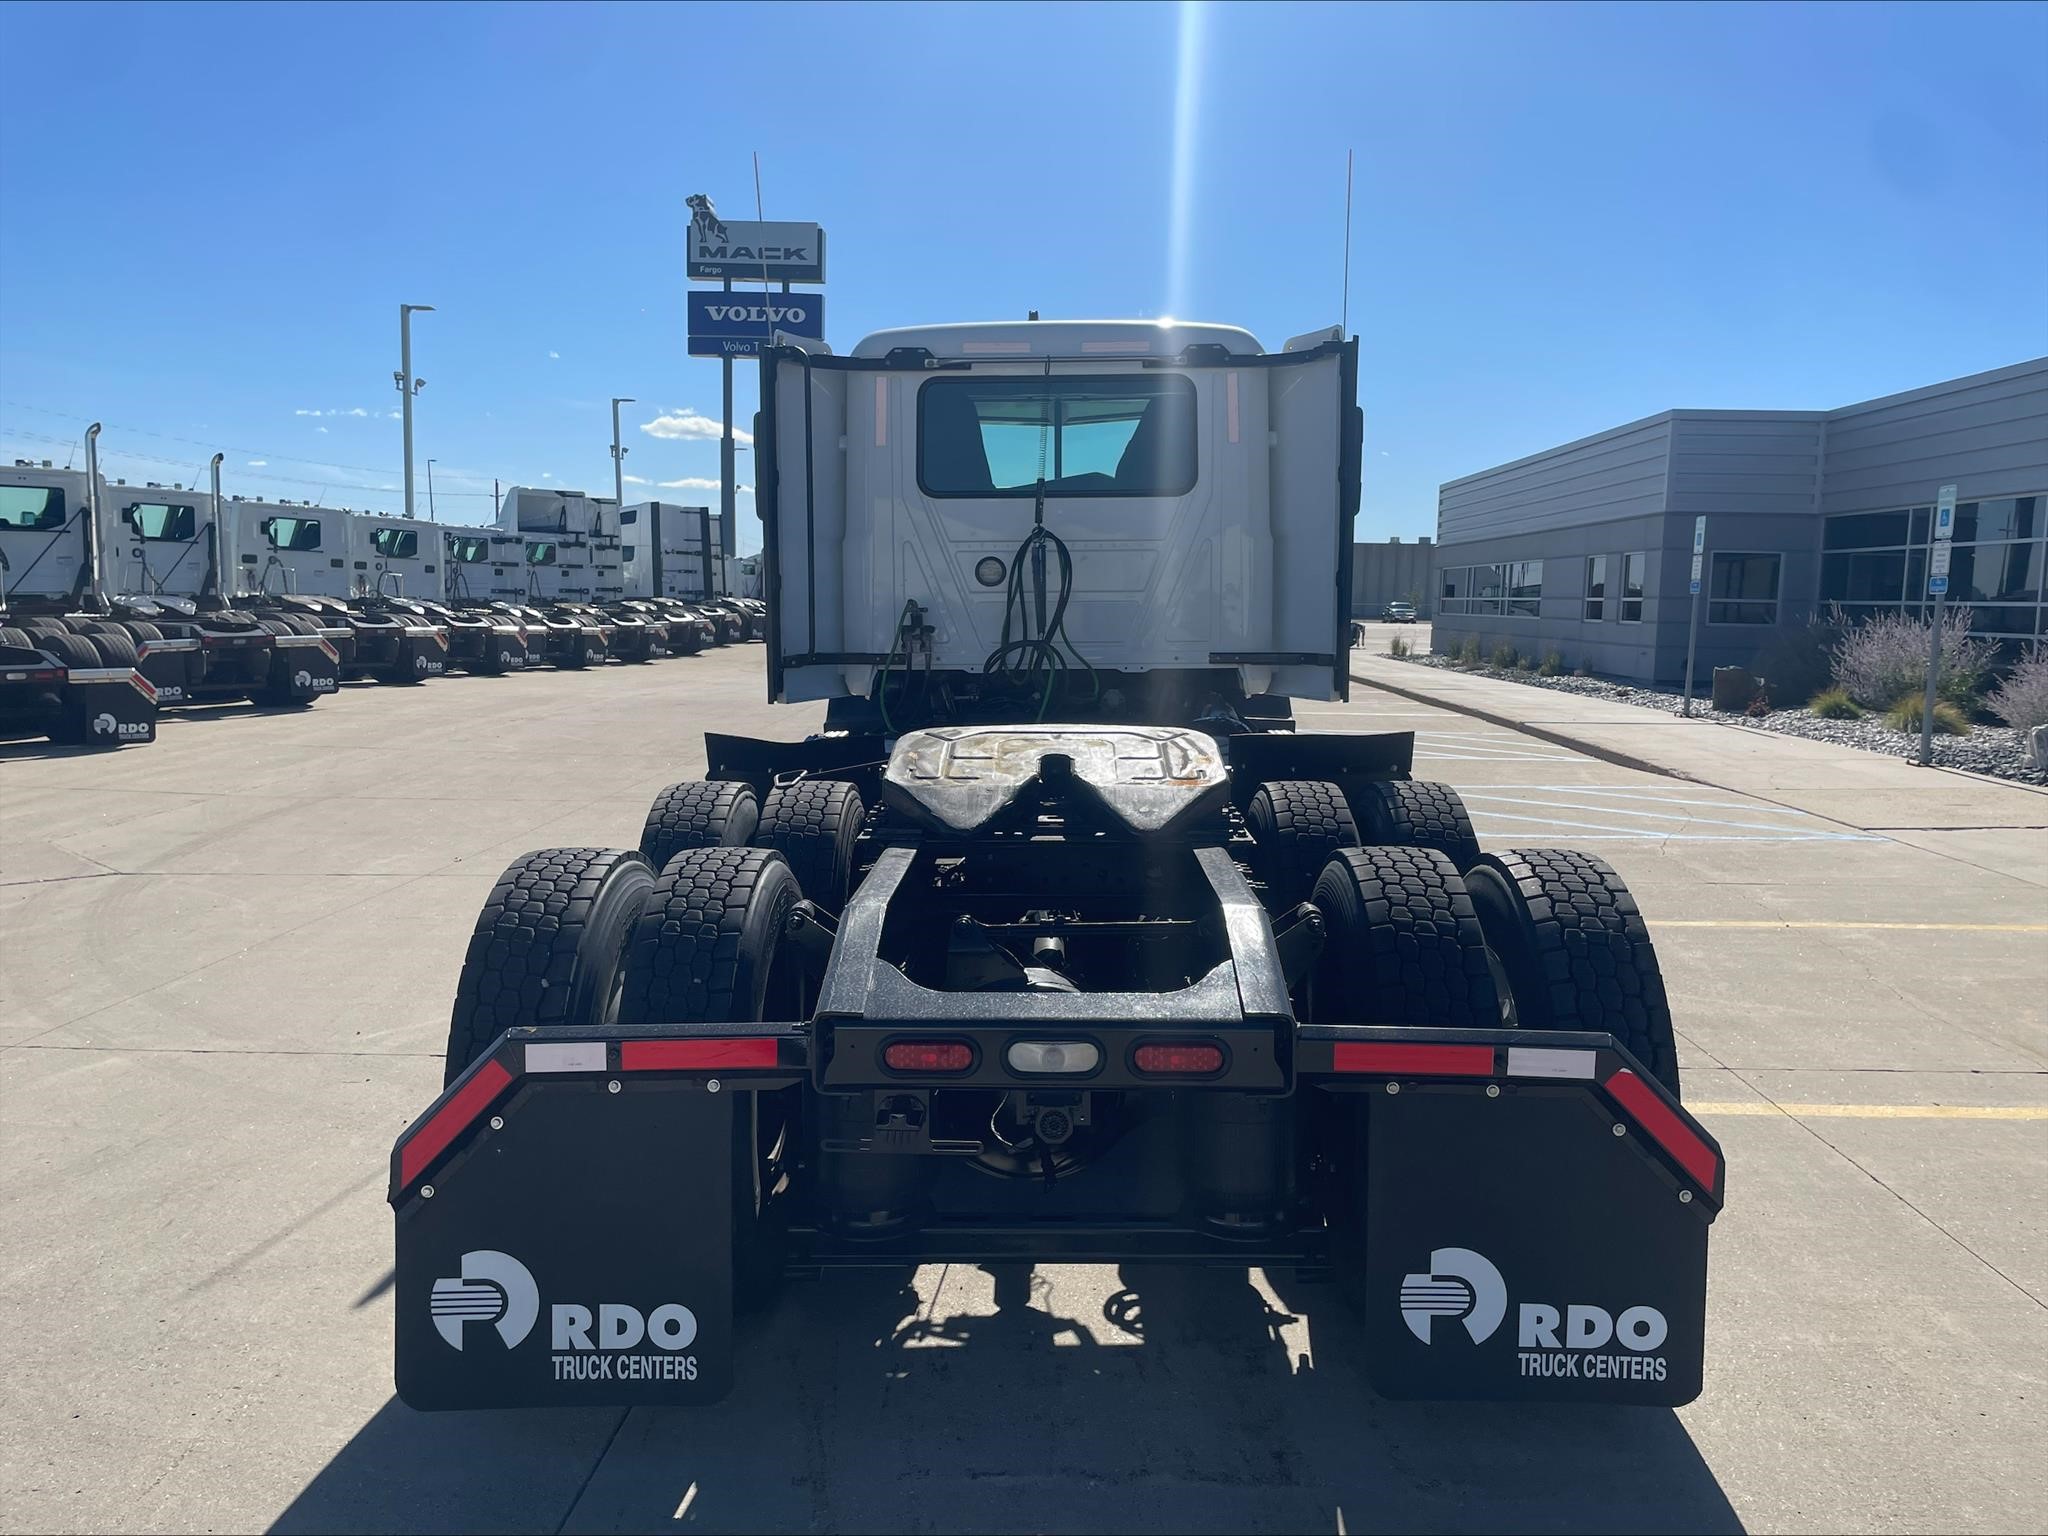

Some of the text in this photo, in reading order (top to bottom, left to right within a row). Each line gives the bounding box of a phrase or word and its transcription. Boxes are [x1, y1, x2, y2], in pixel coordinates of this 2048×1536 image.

[699, 246, 808, 261] MACK
[700, 265, 722, 275] Fargo
[704, 306, 807, 323] VOLVO
[722, 341, 751, 352] Volvo
[312, 677, 334, 687] RDO
[118, 722, 149, 734] RDO
[551, 1303, 698, 1351] RDO
[1518, 1303, 1668, 1352] RDO
[552, 1356, 698, 1381] TRUCK CENTERS
[1518, 1353, 1667, 1382] TRUCK CENTERS
